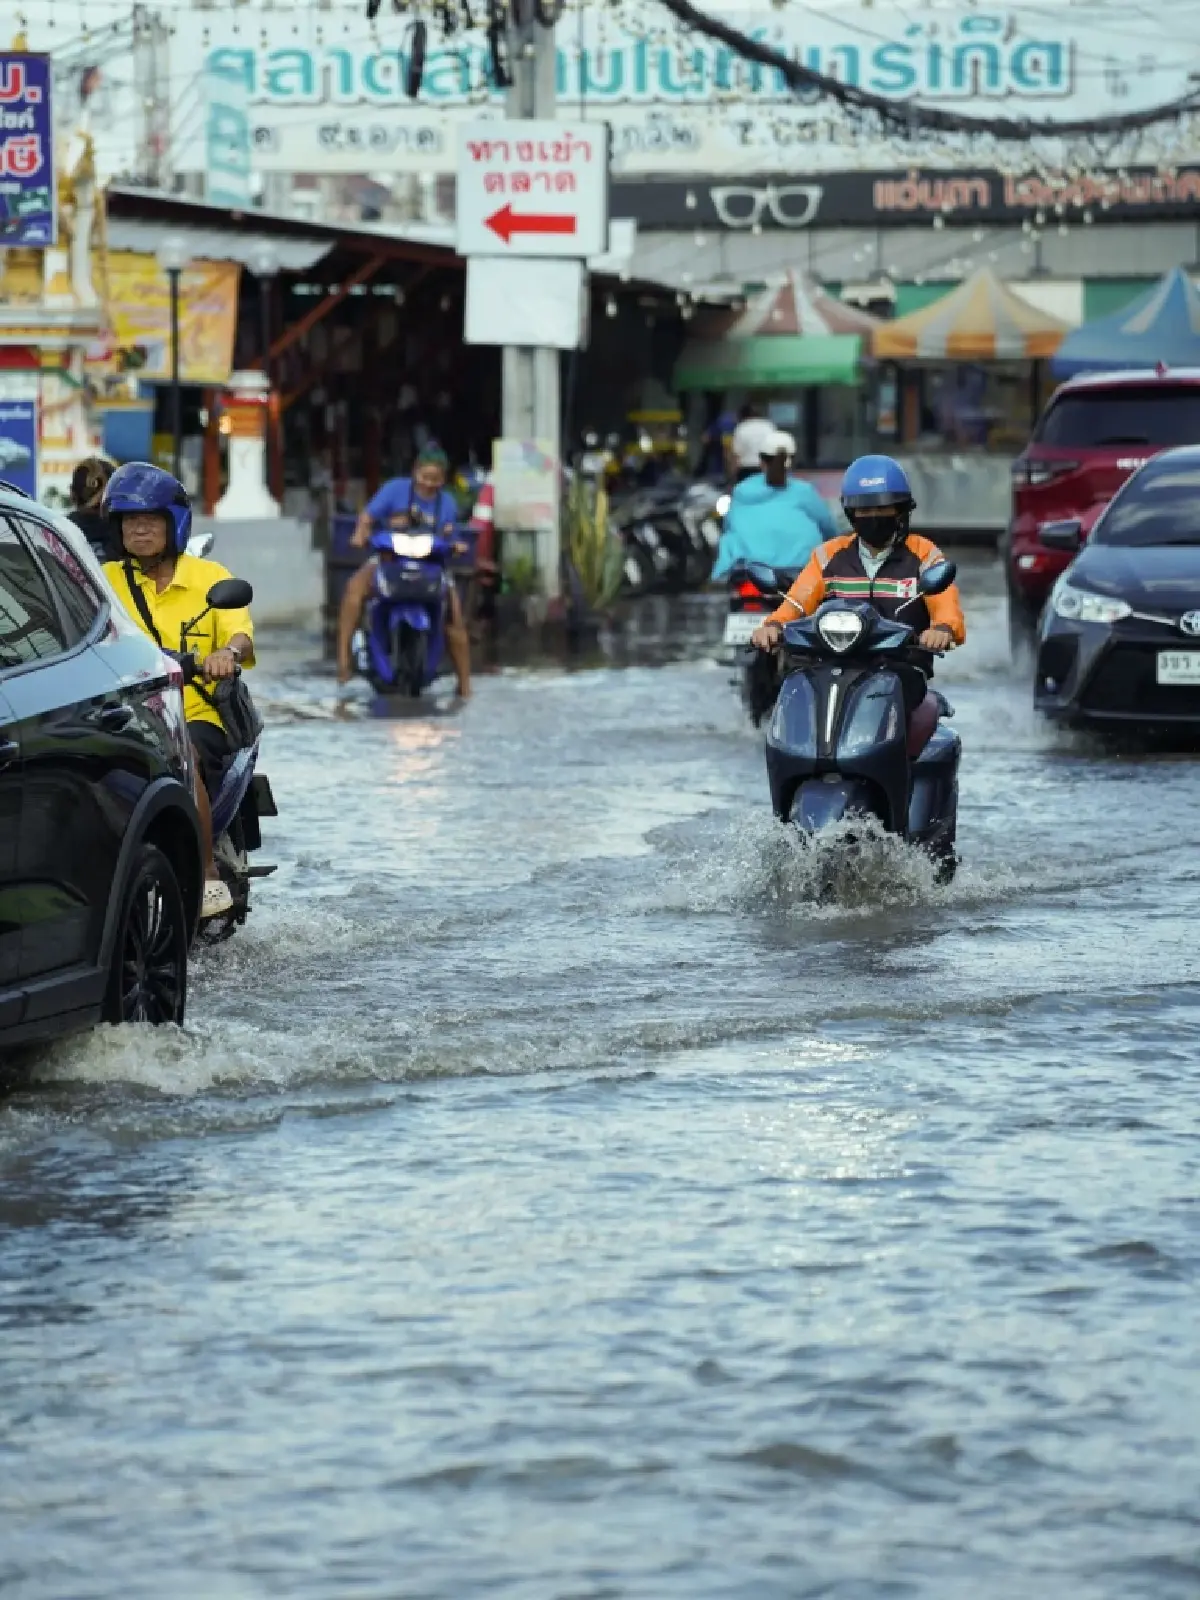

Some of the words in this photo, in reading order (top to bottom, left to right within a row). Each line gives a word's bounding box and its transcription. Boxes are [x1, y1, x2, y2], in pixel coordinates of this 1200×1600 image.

[466, 131, 592, 162] ทางเข้า
[483, 170, 576, 194] ตลาด
